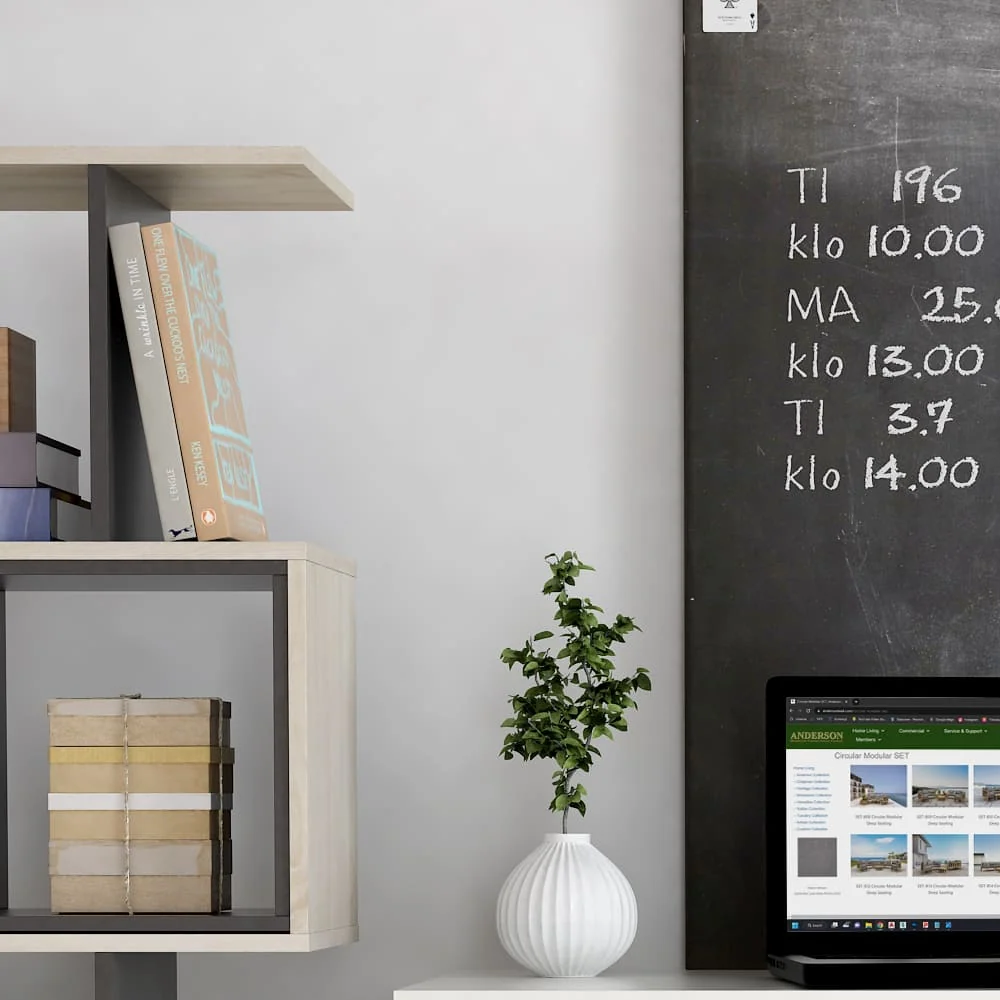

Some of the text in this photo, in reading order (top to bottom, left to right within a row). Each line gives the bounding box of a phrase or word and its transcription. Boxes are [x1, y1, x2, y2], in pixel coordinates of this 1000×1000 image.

[893, 165, 962, 204] 196
[151, 227, 164, 247] ONE
[788, 223, 985, 260] klo 10.00
[155, 248, 169, 273] FLEW
[159, 273, 173, 298] OVER
[126, 257, 154, 359] A wrinkle IN TIME
[164, 297, 177, 315] THE
[787, 286, 860, 323] MA
[176, 363, 190, 384] NEST
[788, 342, 985, 379] klo 13.00
[887, 398, 954, 437] 3.7
[191, 441, 208, 487] KEN KESEY
[785, 454, 980, 492] klo 14.00
[790, 731, 844, 740] ANDERSON
[834, 751, 910, 760] Circular Modular SET
